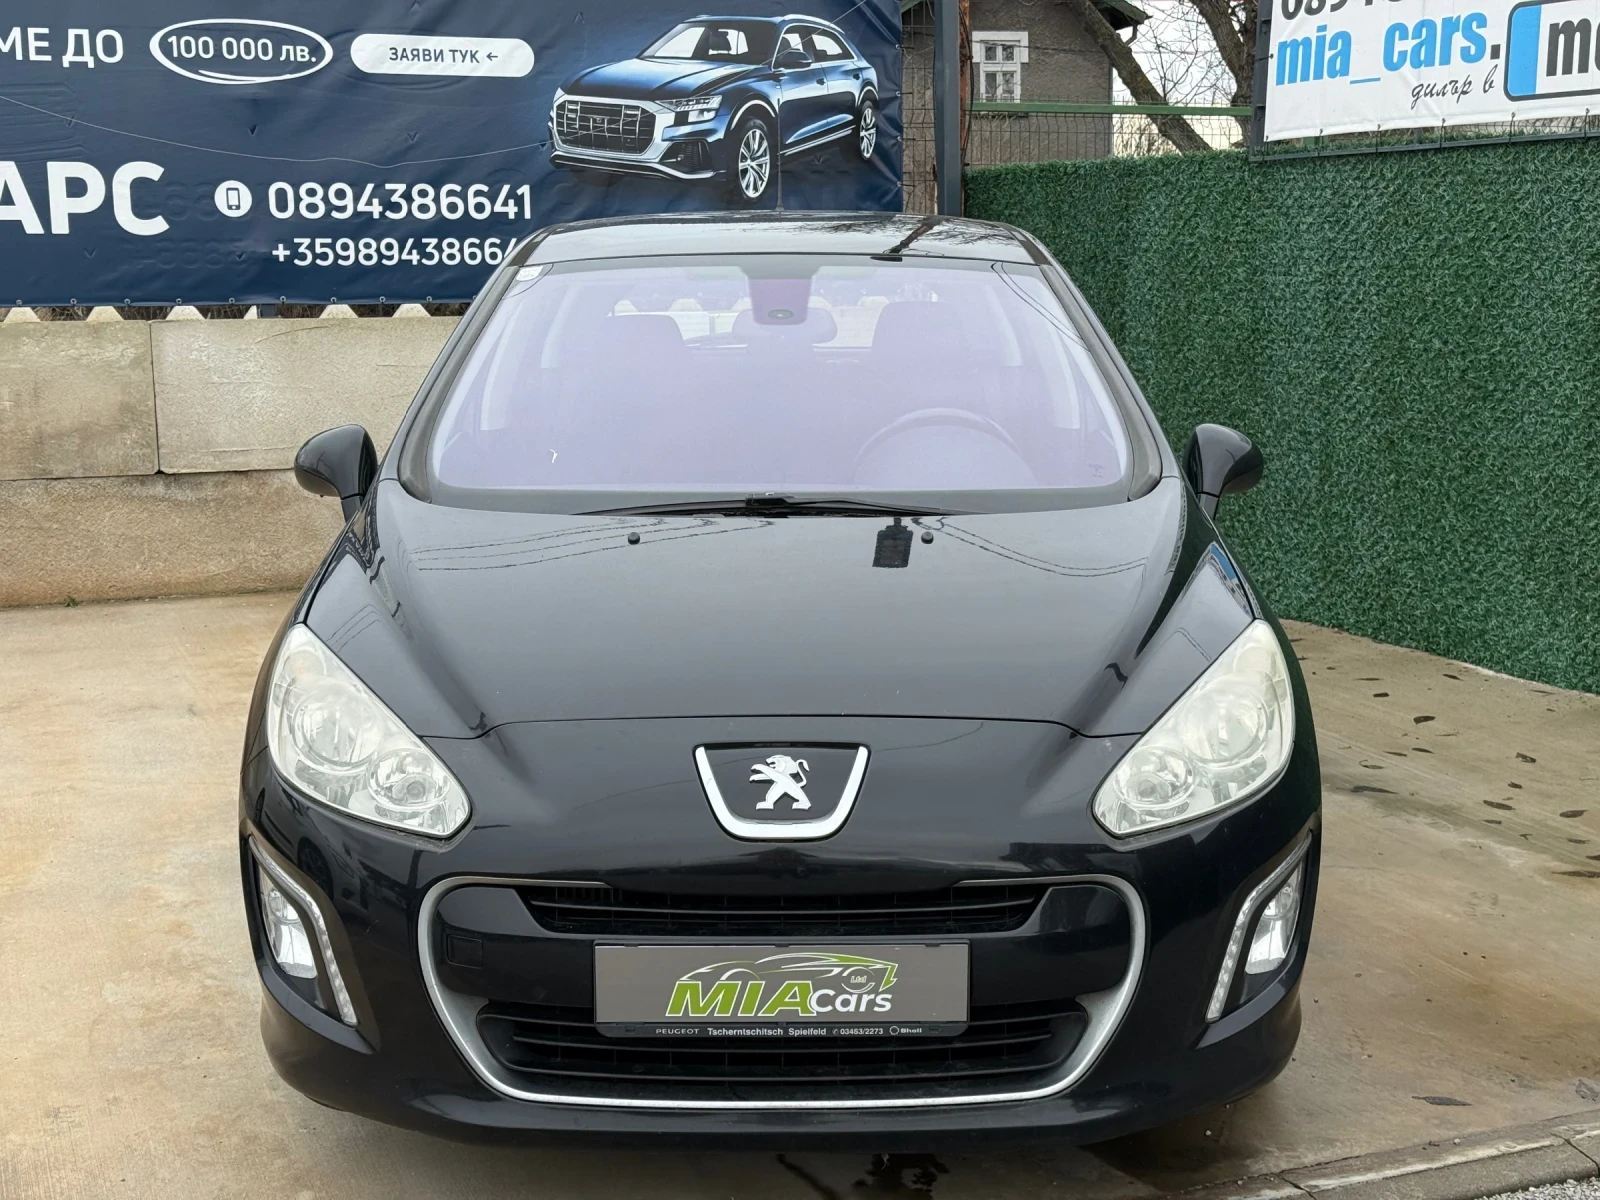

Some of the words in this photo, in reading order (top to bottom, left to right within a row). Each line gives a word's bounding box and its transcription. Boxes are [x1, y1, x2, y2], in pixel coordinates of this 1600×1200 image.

[62, 28, 124, 68] ДО
[166, 35, 215, 59] 100
[221, 36, 273, 61] 000
[279, 45, 317, 63] лв.
[389, 47, 445, 63] ЗАЯВИ
[448, 49, 480, 64] ТУК
[268, 181, 531, 220] 0894386641
[665, 980, 817, 1017] MIA
[810, 988, 893, 1013] Cars
[707, 1027, 783, 1036] Tscherntschitsch
[788, 1027, 827, 1037] Spielfeld
